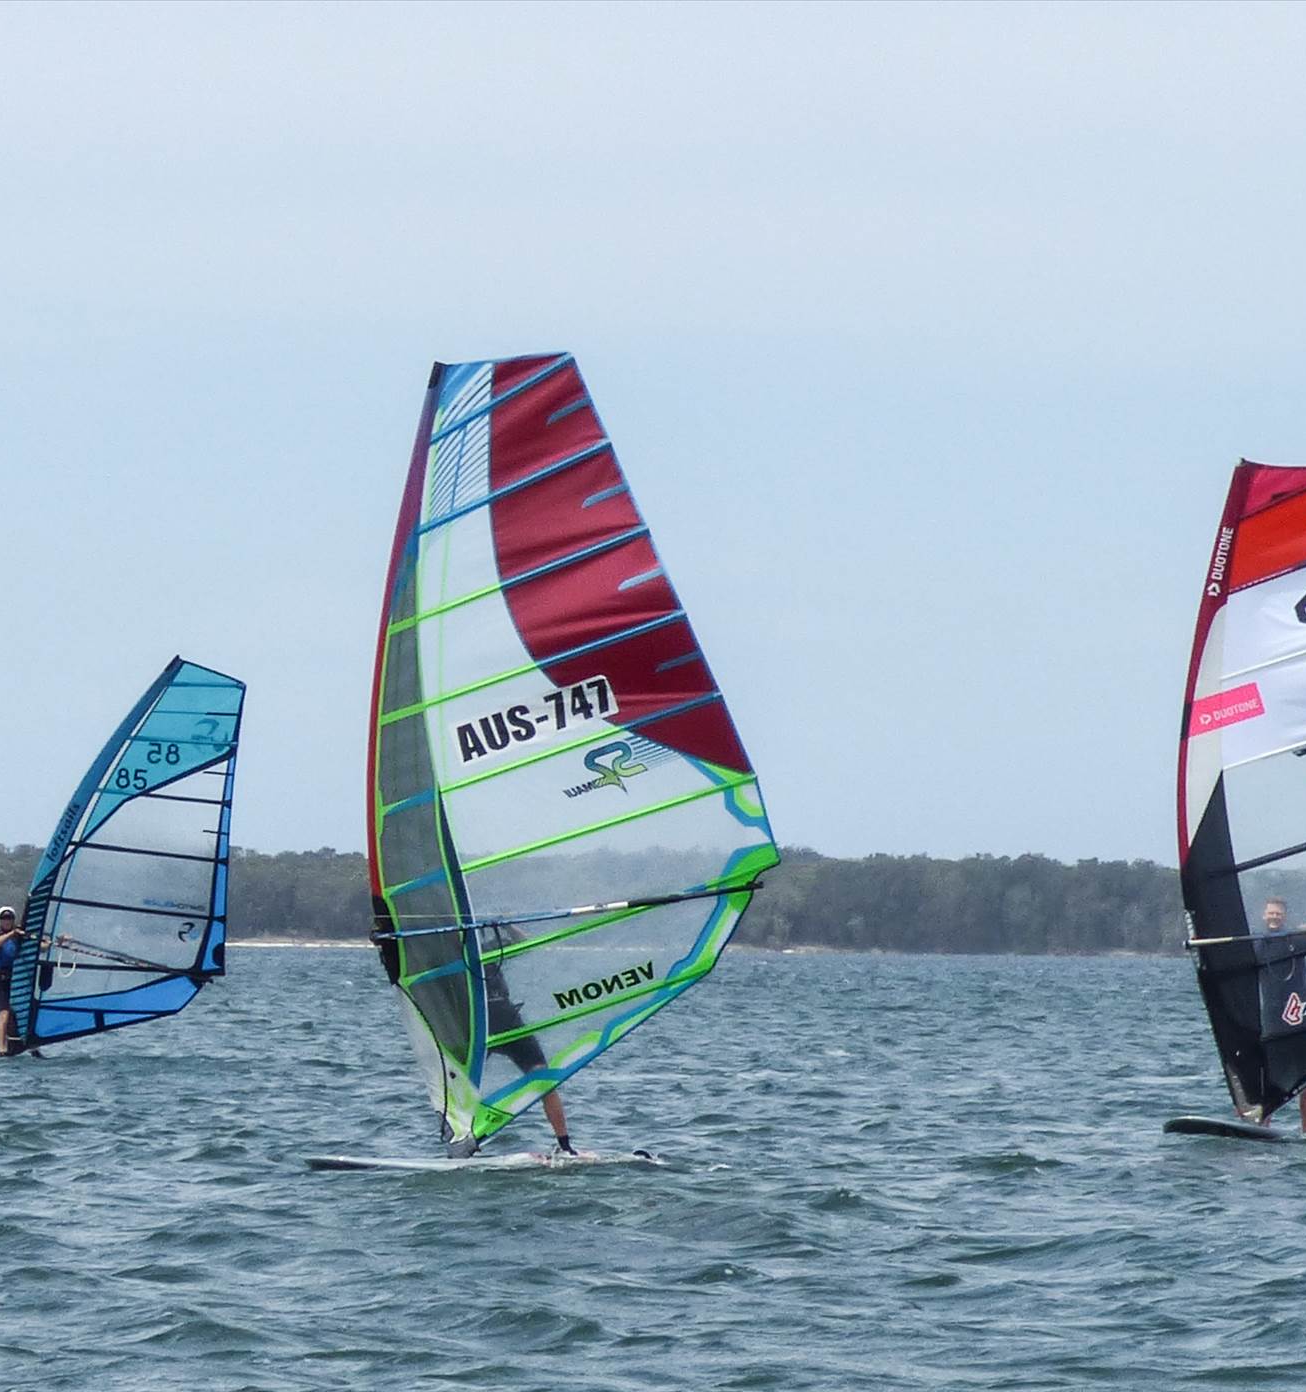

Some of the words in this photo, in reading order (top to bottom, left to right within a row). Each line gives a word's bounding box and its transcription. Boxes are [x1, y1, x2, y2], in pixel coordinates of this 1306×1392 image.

[1210, 526, 1234, 581] DUOTONE
[456, 678, 610, 763] AUS-747
[1212, 698, 1259, 721] DUOTONE
[115, 767, 148, 790] 85
